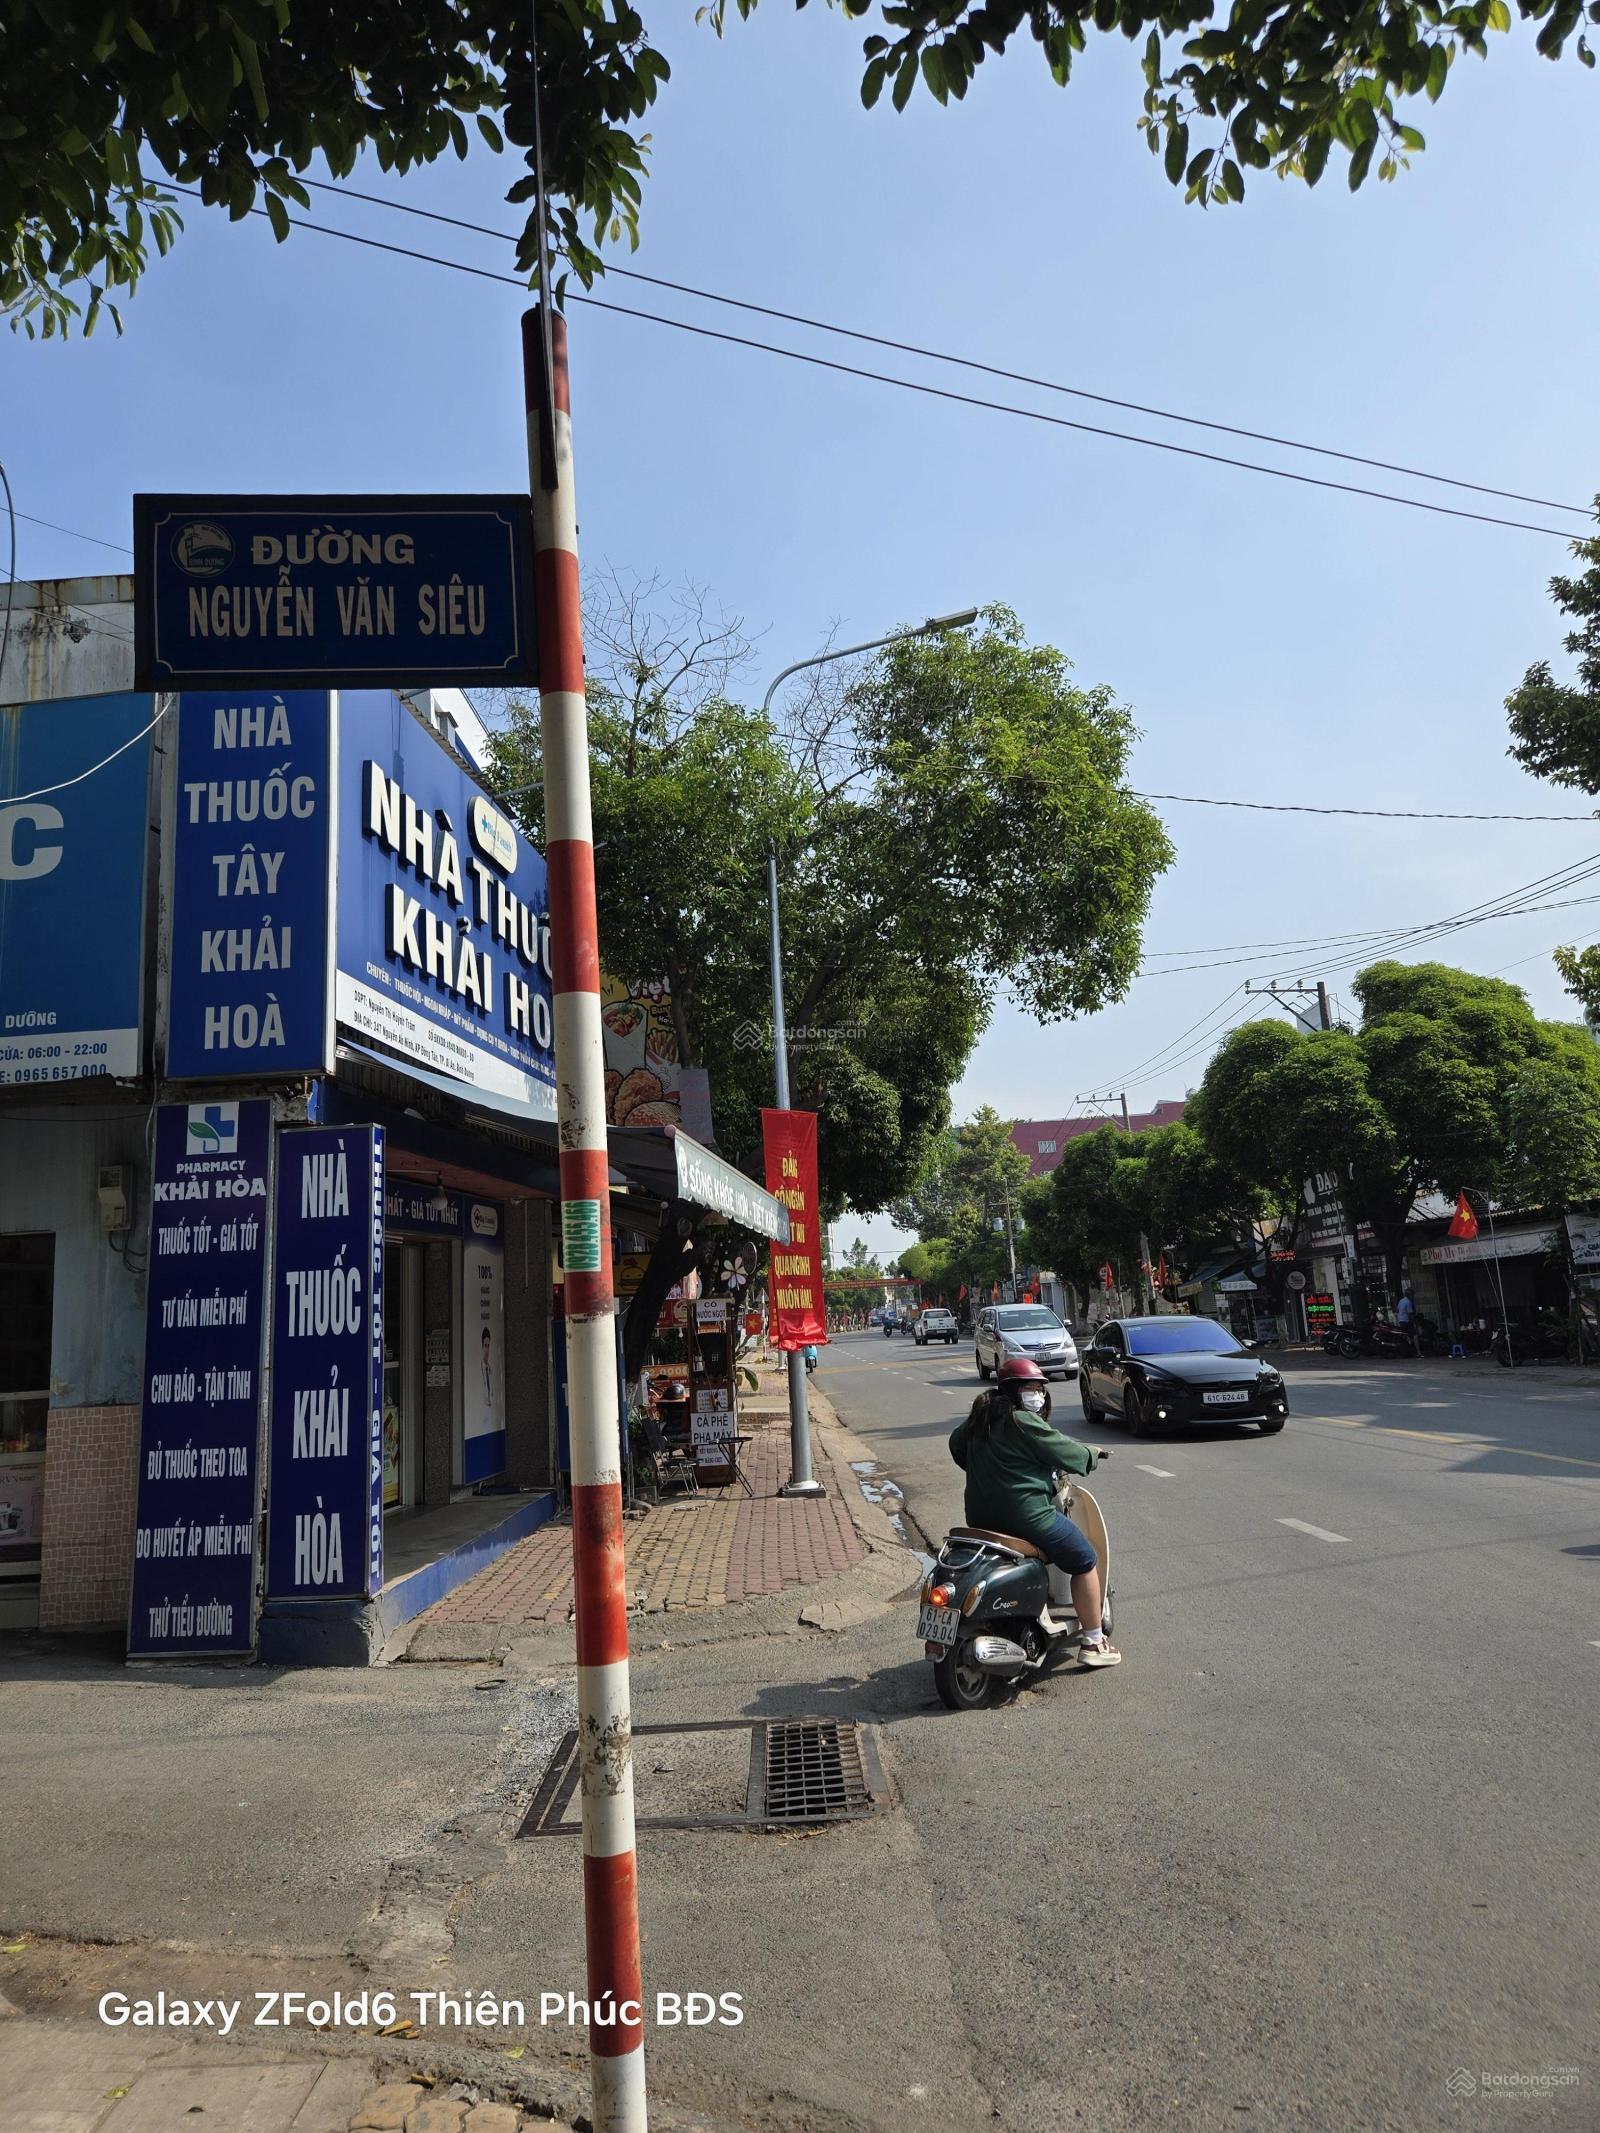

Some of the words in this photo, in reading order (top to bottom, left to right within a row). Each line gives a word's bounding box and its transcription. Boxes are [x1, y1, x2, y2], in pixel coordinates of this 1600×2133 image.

[250, 524, 416, 566] ĐƯỜNG
[189, 564, 315, 638] NGUYỄN
[336, 576, 396, 636] VĂN
[418, 573, 486, 636] SIÊU
[213, 695, 292, 750] NHÀ
[184, 762, 316, 824] THUỐC
[367, 760, 464, 905] NHÀ
[212, 843, 286, 897] TÂY
[201, 914, 292, 973] KHẢI
[390, 884, 492, 1013] KHẢI
[508, 972, 556, 1050] HO
[5, 1010, 57, 1029] DƯỠNG
[204, 992, 286, 1050] HOÀ
[27, 1046, 61, 1059] 06:00
[74, 1042, 108, 1056] 22:00
[15, 1067, 48, 1083] 0965
[52, 1065, 77, 1080] 657
[81, 1063, 107, 1079] 000
[154, 1174, 209, 1202] KHẢI
[215, 1174, 267, 1199] HÒA
[176, 1160, 247, 1174] PHARMACY
[301, 1138, 350, 1219] NHÀ
[689, 1158, 714, 1201] SỐNG
[714, 1175, 734, 1211] KHỎE
[411, 1200, 424, 1220] GIÁ
[158, 1216, 191, 1255] THUỐC
[193, 1215, 212, 1254] TỐT
[220, 1217, 237, 1252] GIÁ
[240, 1213, 259, 1251] TỐT
[286, 1243, 361, 1338] THUỐC
[477, 1264, 493, 1280] 100%
[162, 1296, 177, 1329] TƯ
[177, 1289, 198, 1328] VẤN
[200, 1287, 227, 1327] MIỄN
[229, 1290, 248, 1325] PHÍ
[151, 1373, 172, 1404] CHU
[174, 1367, 195, 1403] ĐÁO
[204, 1366, 225, 1408] TẬN
[227, 1365, 251, 1400] TÌNH
[292, 1364, 350, 1459] KHẢI
[711, 1413, 728, 1426] PHÊ
[147, 1440, 162, 1480] ĐỦ
[165, 1438, 198, 1479] THUỐC
[200, 1447, 225, 1478] THEO
[228, 1447, 248, 1477] TOA
[694, 1433, 711, 1443] PHA
[136, 1528, 150, 1559] ĐO
[152, 1517, 186, 1558] HUYẾT
[187, 1520, 201, 1557] ÁP
[204, 1515, 232, 1556] MIỄN
[234, 1518, 253, 1555] PHÍ
[294, 1495, 344, 1585] HÒA
[149, 1596, 171, 1639] THỬ
[171, 1593, 194, 1638] TIỂU
[196, 1597, 233, 1637] ĐƯỜNG
[919, 1622, 953, 1642] 029.04
[926, 1607, 953, 1626] 61-CA
